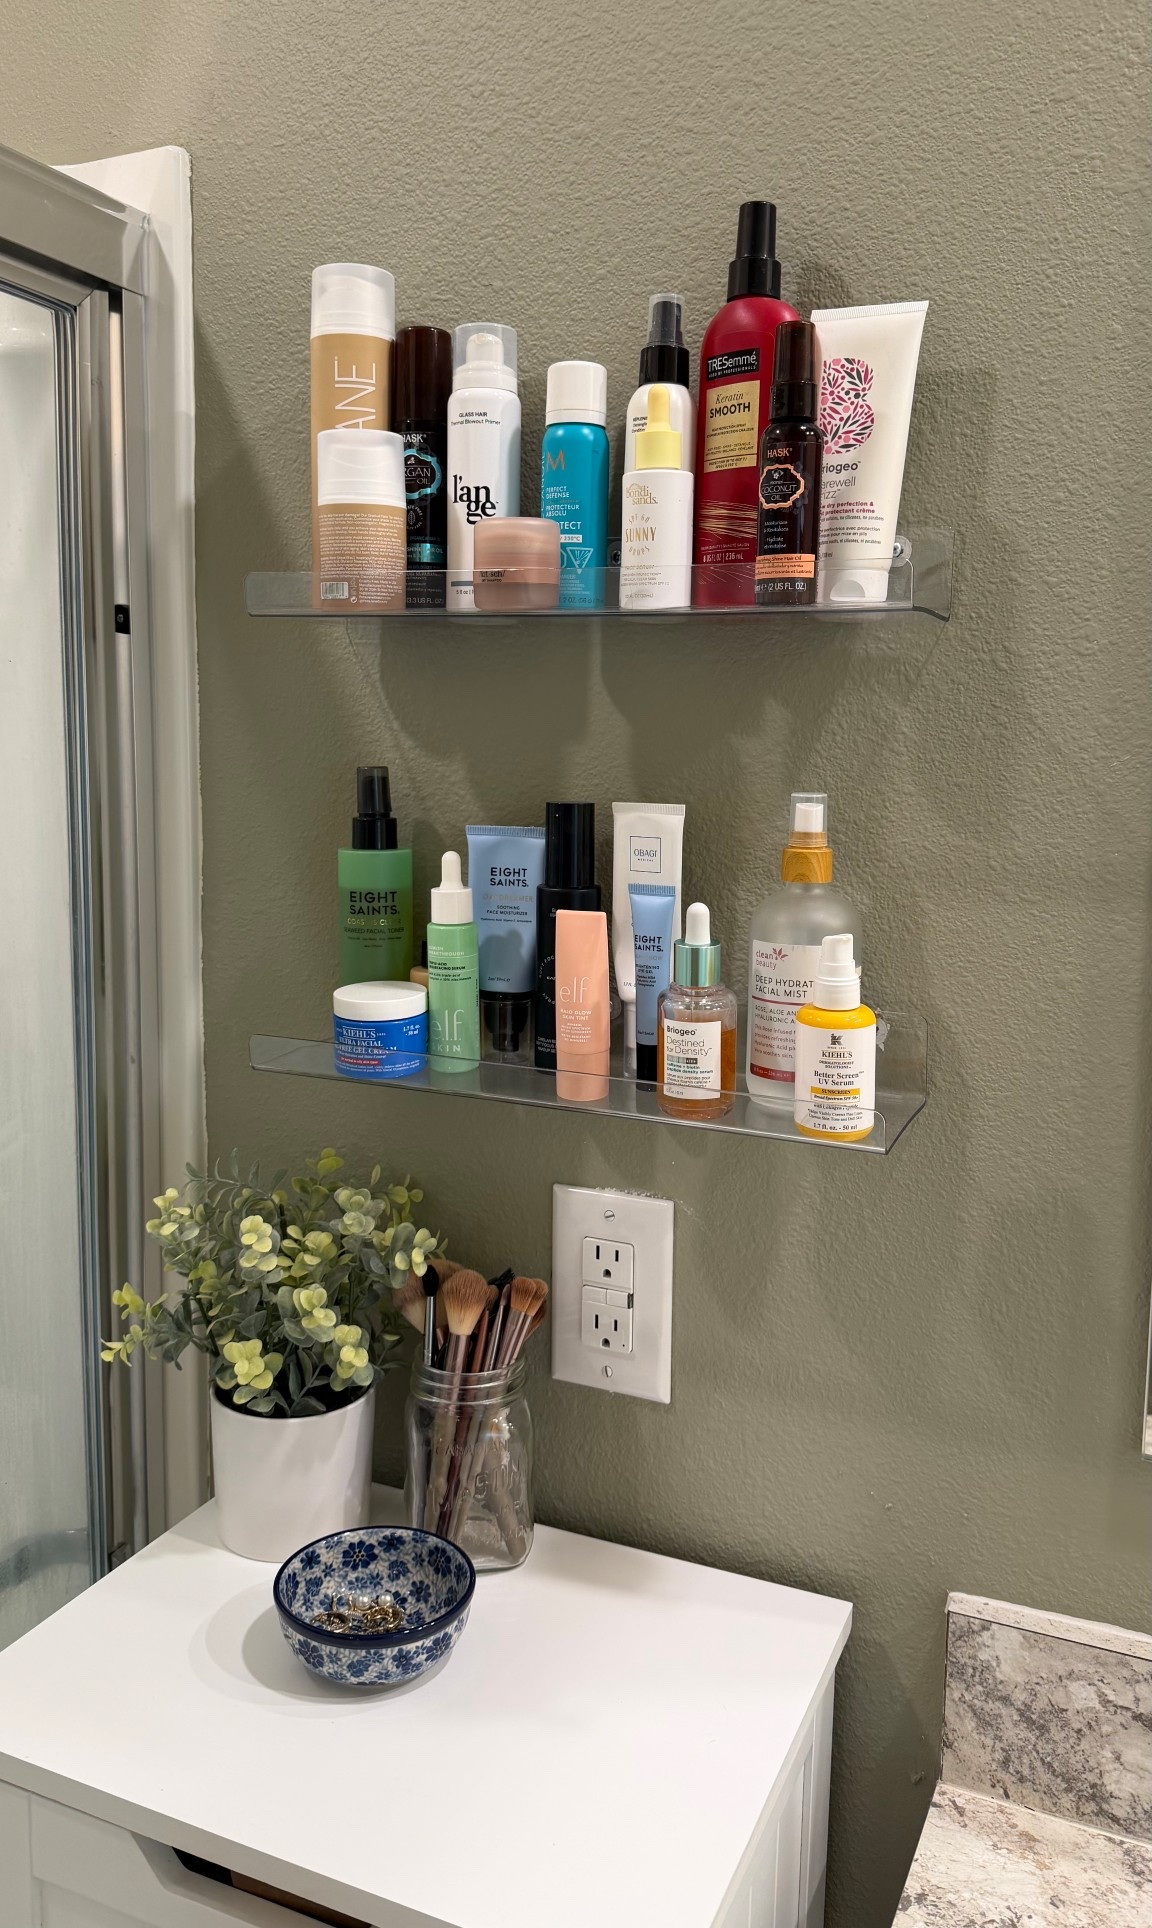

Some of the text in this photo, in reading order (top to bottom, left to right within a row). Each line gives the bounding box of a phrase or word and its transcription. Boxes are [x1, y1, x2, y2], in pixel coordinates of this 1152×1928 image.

[708, 351, 757, 372] TRESemmé
[715, 390, 744, 405] Keratin
[709, 402, 751, 419] SMOOTH
[767, 448, 790, 458] HASK
[546, 450, 565, 473] M
[417, 477, 430, 485] OIL
[626, 485, 649, 498] bondi
[761, 484, 798, 494] COCONUT
[546, 491, 570, 499] DEFENSE
[825, 508, 855, 516] protectant
[625, 527, 657, 543] SUNNY
[725, 552, 736, 560] 236
[775, 582, 784, 591] US
[633, 848, 657, 858] OBAGI
[490, 866, 528, 878] EIGHT
[349, 891, 398, 904] EIGHT
[634, 934, 663, 945] EIGHT
[756, 950, 774, 960] clean
[756, 959, 777, 971] beauty
[755, 974, 773, 985] DEEP
[560, 976, 591, 1003] elf
[755, 984, 808, 998] FACIAL MIST
[769, 1008, 785, 1016] ALOE
[755, 1013, 789, 1024] HYALURONIC
[343, 1027, 376, 1039] KIEHL'S
[666, 1025, 696, 1037] Briogeo
[666, 1036, 705, 1047] Destined
[431, 1043, 461, 1052] SKIN
[674, 1045, 710, 1057] Density
[763, 1050, 781, 1058] soothes
[821, 1050, 853, 1059] KIEHL'S
[814, 1070, 859, 1080] Better Screen
